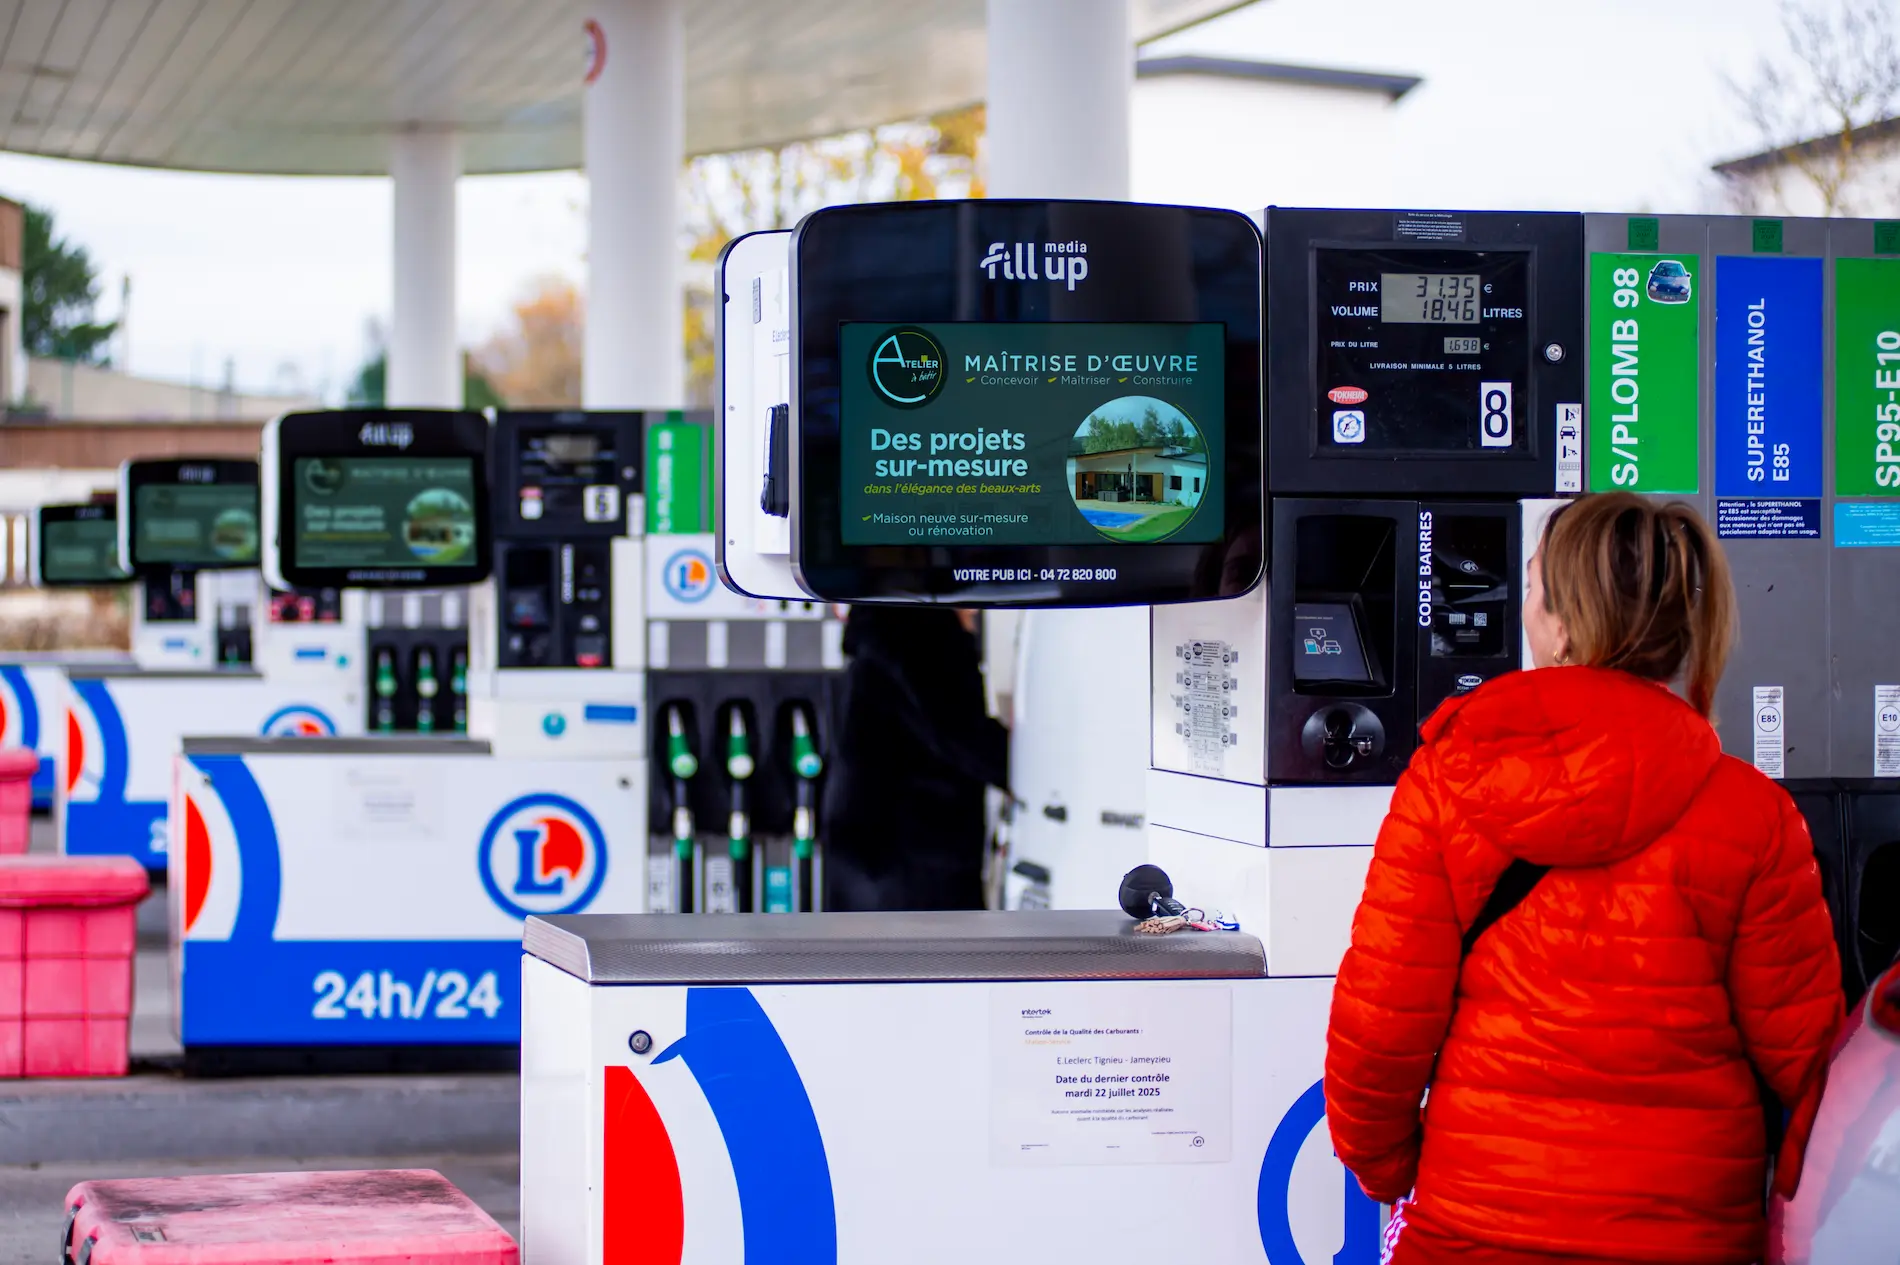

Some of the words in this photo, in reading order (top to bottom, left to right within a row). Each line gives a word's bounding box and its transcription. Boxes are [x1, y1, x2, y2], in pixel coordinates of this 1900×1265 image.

[1044, 240, 1088, 253] media
[980, 242, 1038, 280] fill
[1044, 256, 1088, 290] up
[1349, 281, 1378, 292] PRIX
[1483, 284, 1493, 294] €
[1613, 268, 1640, 308] 98
[1331, 306, 1378, 317] VOLUME
[1483, 308, 1523, 318] LITRES
[965, 351, 1077, 372] MAÎTRISE
[1088, 354, 1198, 372] D'ŒUVRE
[980, 376, 1039, 385] Concevoir
[1061, 375, 1110, 385] Maîtriser
[1133, 375, 1193, 385] Construire
[1328, 390, 1365, 402] TOKHEIM
[1748, 298, 1765, 482] SUPERETHANOL
[1611, 318, 1639, 486] S/PLOMB
[1484, 389, 1508, 438] 8
[1876, 331, 1900, 488] SP95-E10
[871, 428, 922, 451] Des
[930, 428, 1026, 455] projets
[875, 458, 1029, 477] sur-mesure
[1773, 443, 1790, 482] E85
[864, 484, 892, 494] dans
[895, 483, 953, 496] l'élégance
[956, 484, 977, 494] des
[980, 483, 1041, 494] beaux-arts
[873, 513, 916, 524] Maison
[920, 515, 957, 523] neuve
[960, 514, 1028, 523] sur-mesure
[909, 528, 924, 536] ou
[928, 525, 993, 536] rénovation
[1420, 511, 1432, 576] BARRES
[954, 569, 990, 581] VOTRE
[992, 569, 1015, 580] PUB
[1017, 569, 1031, 580] ICI
[1040, 569, 1054, 580] 04
[1057, 569, 1070, 580] 72
[1072, 569, 1093, 580] 820
[1095, 569, 1117, 580] 800
[1419, 580, 1432, 627] CODE
[312, 970, 501, 1020] 24h/24
[1095, 1056, 1123, 1065] Tignieu
[1130, 1056, 1171, 1065] Jameyzieu
[1056, 1075, 1078, 1084] Date
[1080, 1074, 1092, 1083] du
[1095, 1074, 1128, 1083] dernier
[1131, 1073, 1170, 1082] contrôle
[1065, 1089, 1092, 1098] mardi
[1095, 1089, 1106, 1097] 22
[1108, 1088, 1135, 1098] juillet
[1138, 1088, 1161, 1096] 2025
